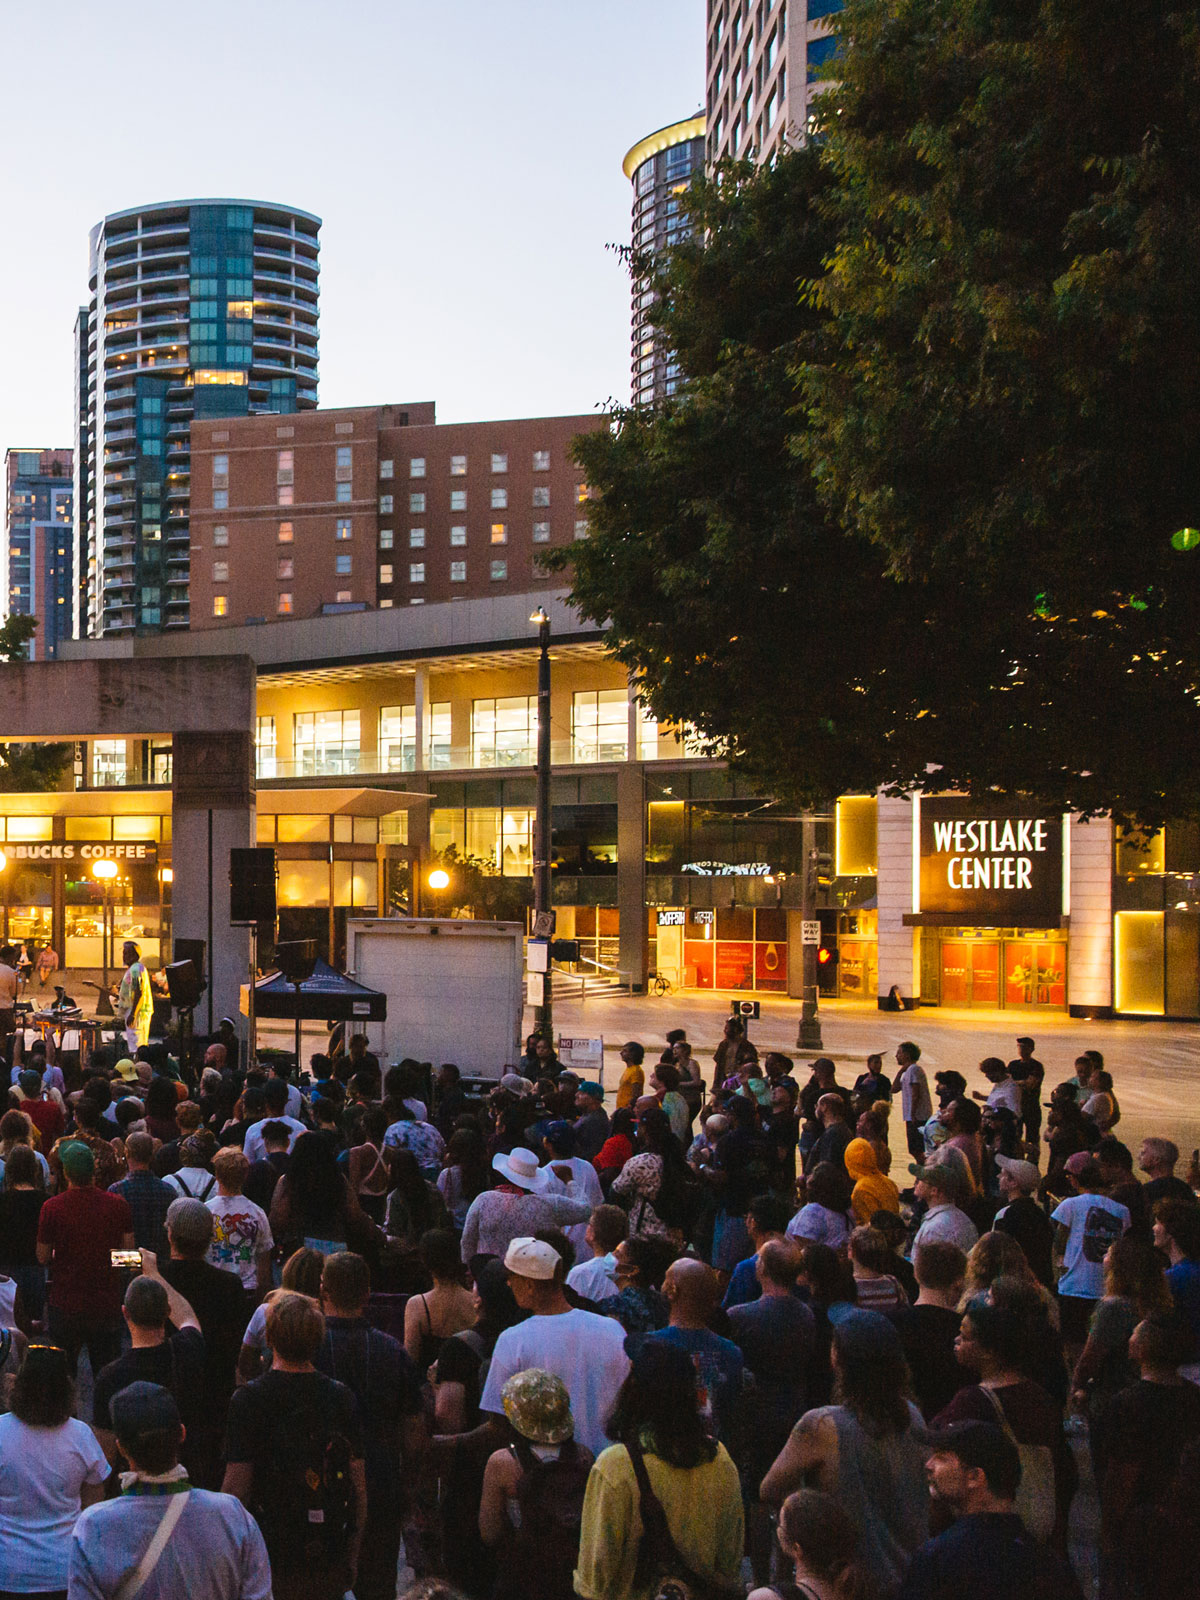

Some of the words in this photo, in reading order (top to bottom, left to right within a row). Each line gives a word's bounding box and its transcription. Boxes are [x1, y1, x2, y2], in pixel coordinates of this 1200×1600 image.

[933, 819, 1048, 852] WESTLAKE
[80, 845, 146, 858] COFFEE
[947, 857, 1033, 889] CENTER
[561, 1039, 571, 1047] NO
